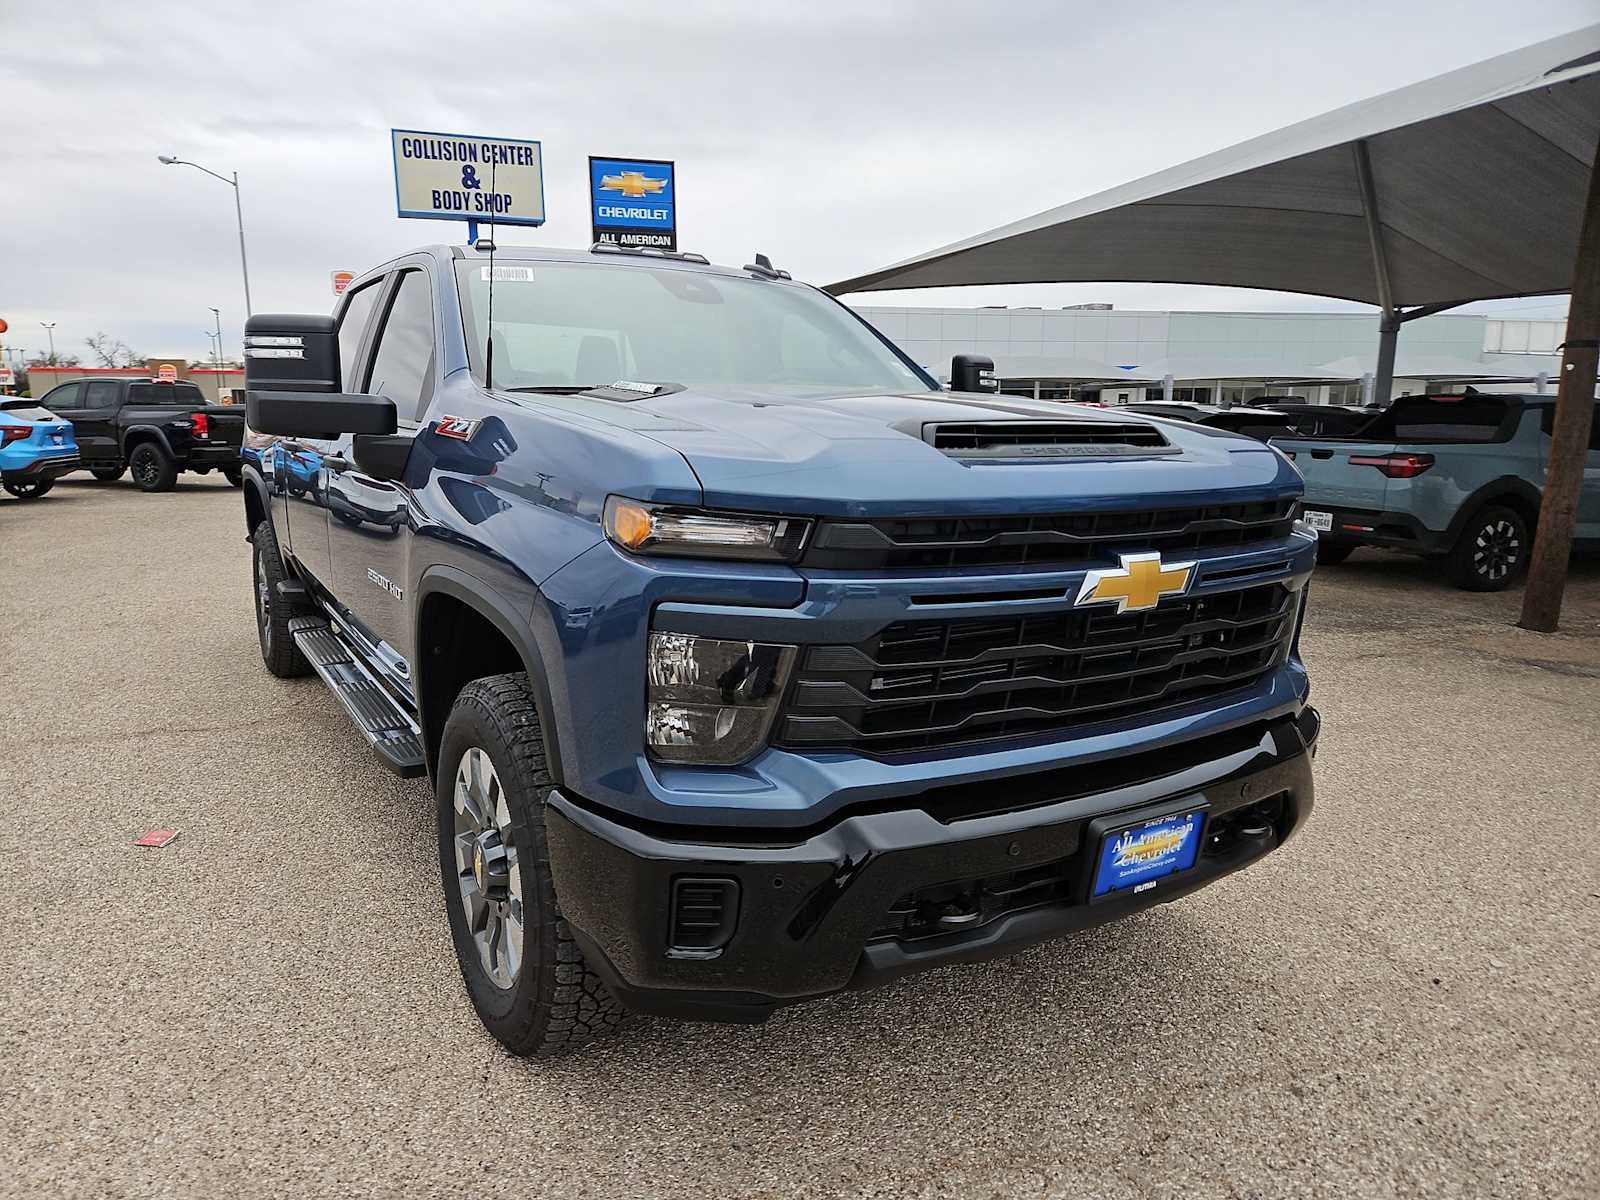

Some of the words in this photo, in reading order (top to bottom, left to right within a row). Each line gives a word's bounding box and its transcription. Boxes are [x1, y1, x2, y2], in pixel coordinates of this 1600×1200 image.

[402, 138, 477, 163] COLLISION
[481, 145, 534, 167] CENTER
[461, 164, 481, 190] &
[432, 189, 473, 211] BODY
[474, 193, 513, 214] SHOP
[598, 206, 669, 221] CHEVROLET
[599, 233, 619, 245] ALL
[620, 234, 672, 247] AMERICAN
[435, 415, 481, 442] Z71
[367, 567, 391, 591] 2500
[389, 582, 403, 601] HD
[1111, 836, 1133, 854] All
[1119, 842, 1182, 867] Chevrolet
